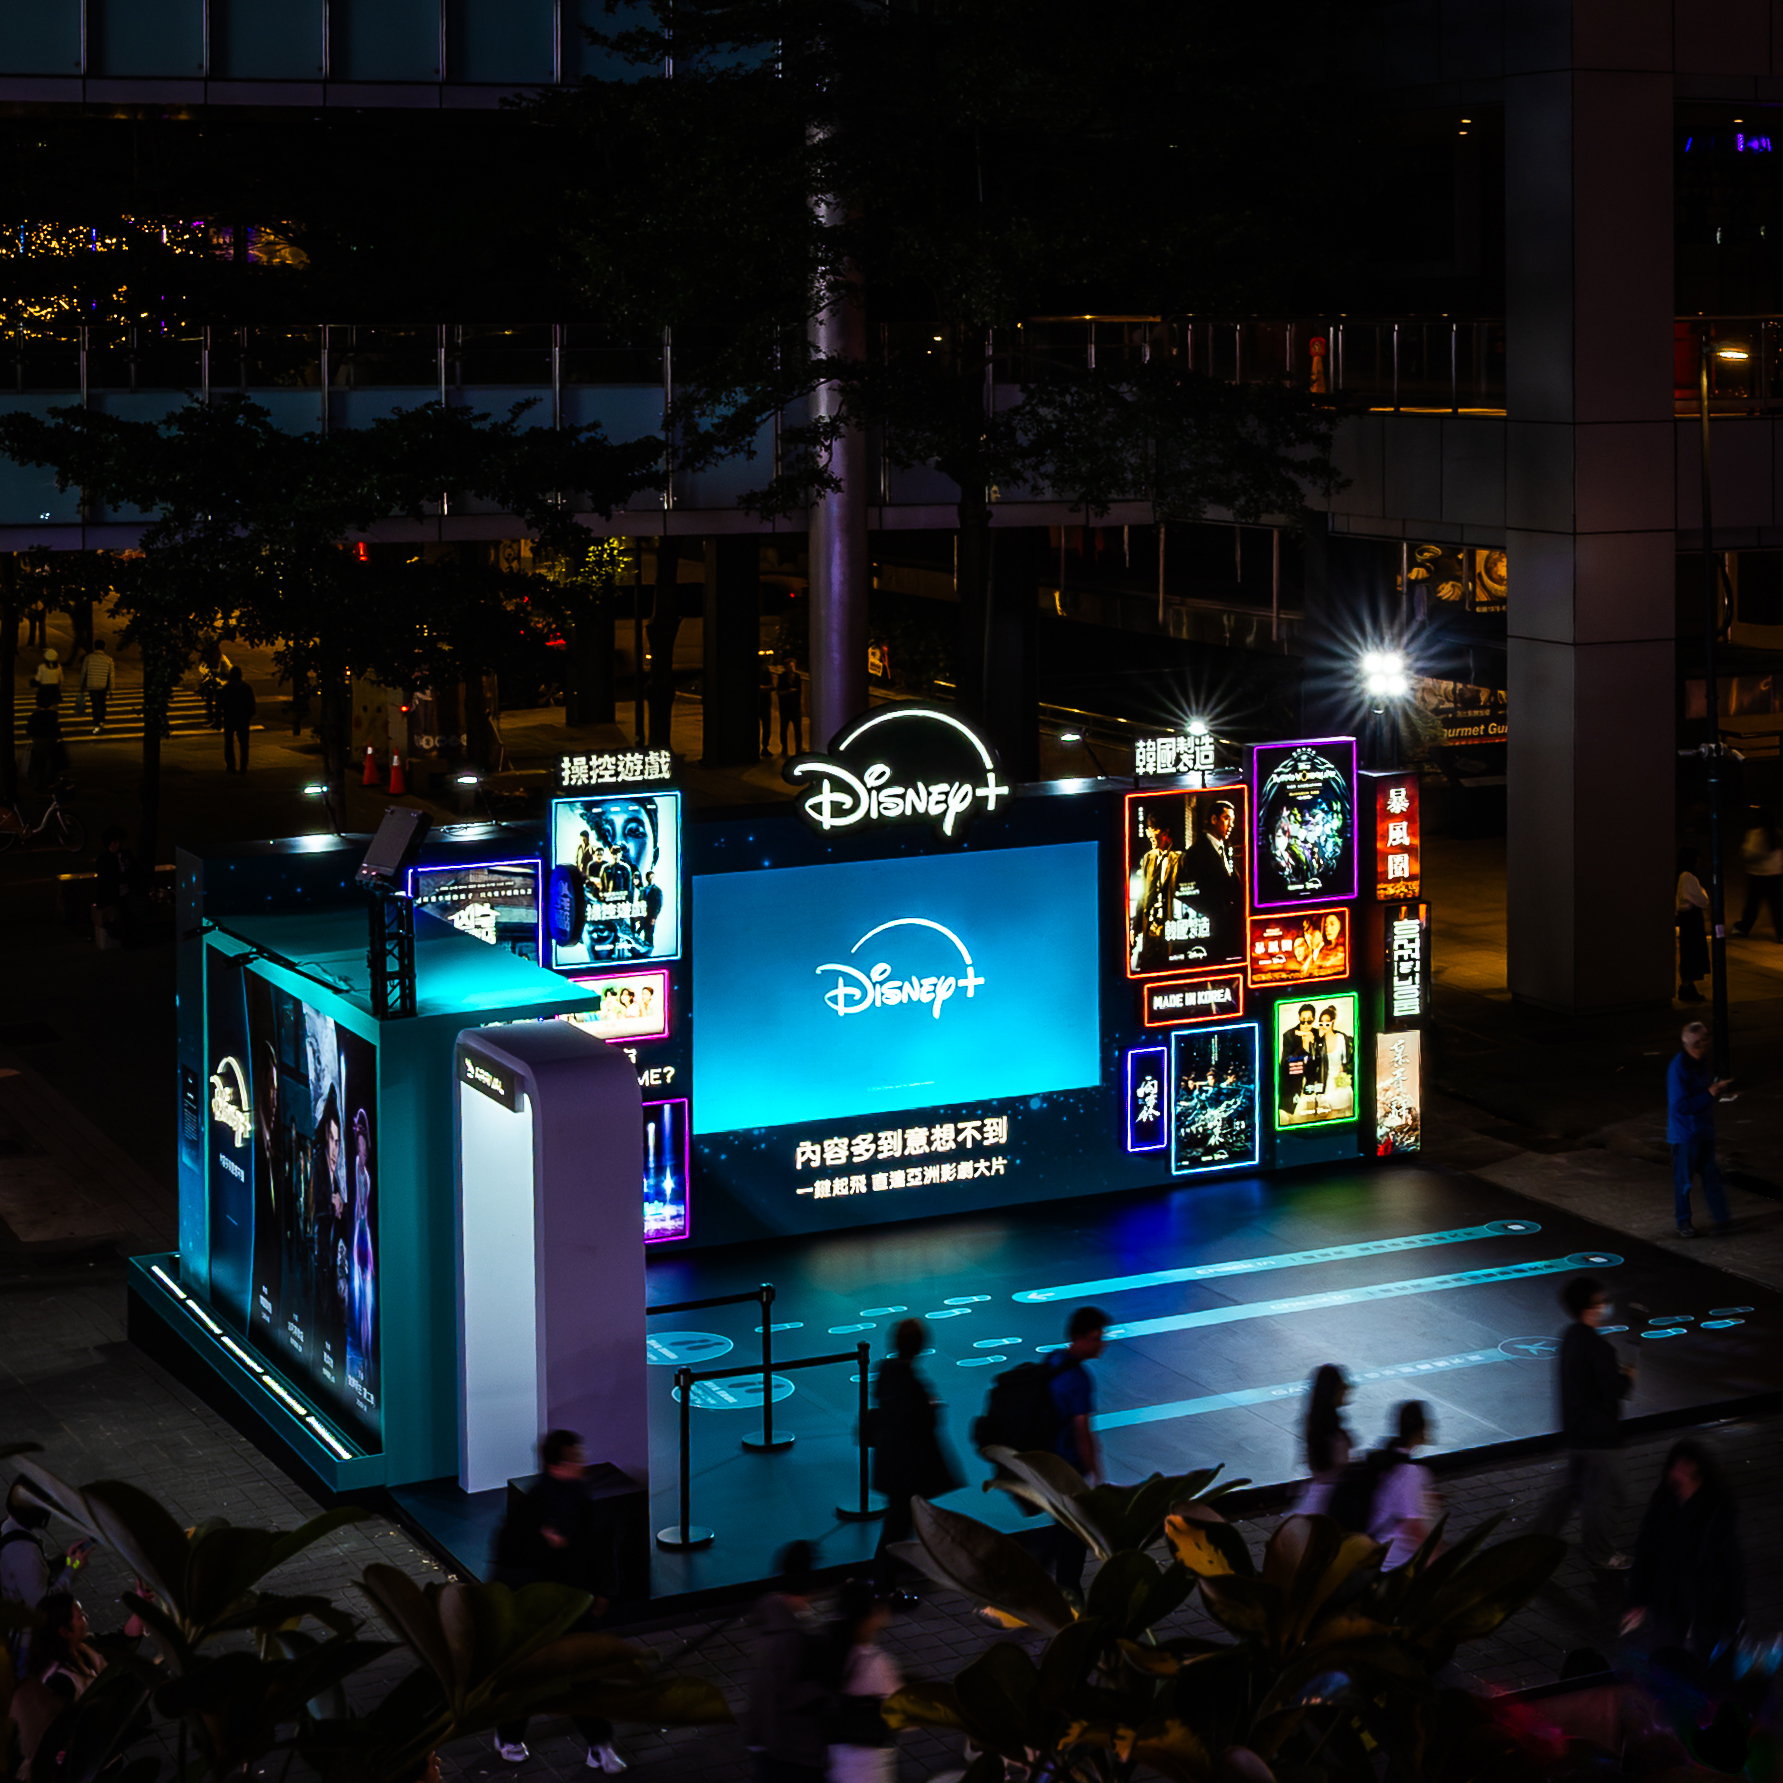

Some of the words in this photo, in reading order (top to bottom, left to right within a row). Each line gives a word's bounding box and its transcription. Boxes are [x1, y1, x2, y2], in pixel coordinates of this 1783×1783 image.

[561, 750, 672, 786] 操控遊戲
[1135, 735, 1215, 775] 韓國製造
[794, 762, 1009, 836] Disney+
[1386, 787, 1410, 880] 暴風圈
[586, 901, 647, 921] 操控遊戲
[815, 962, 985, 1020] Disney+
[1153, 992, 1183, 1010] MADE
[1184, 991, 1197, 1006] IN
[1197, 987, 1232, 1006] KOREA
[796, 1173, 867, 1200] 一鍵起飛
